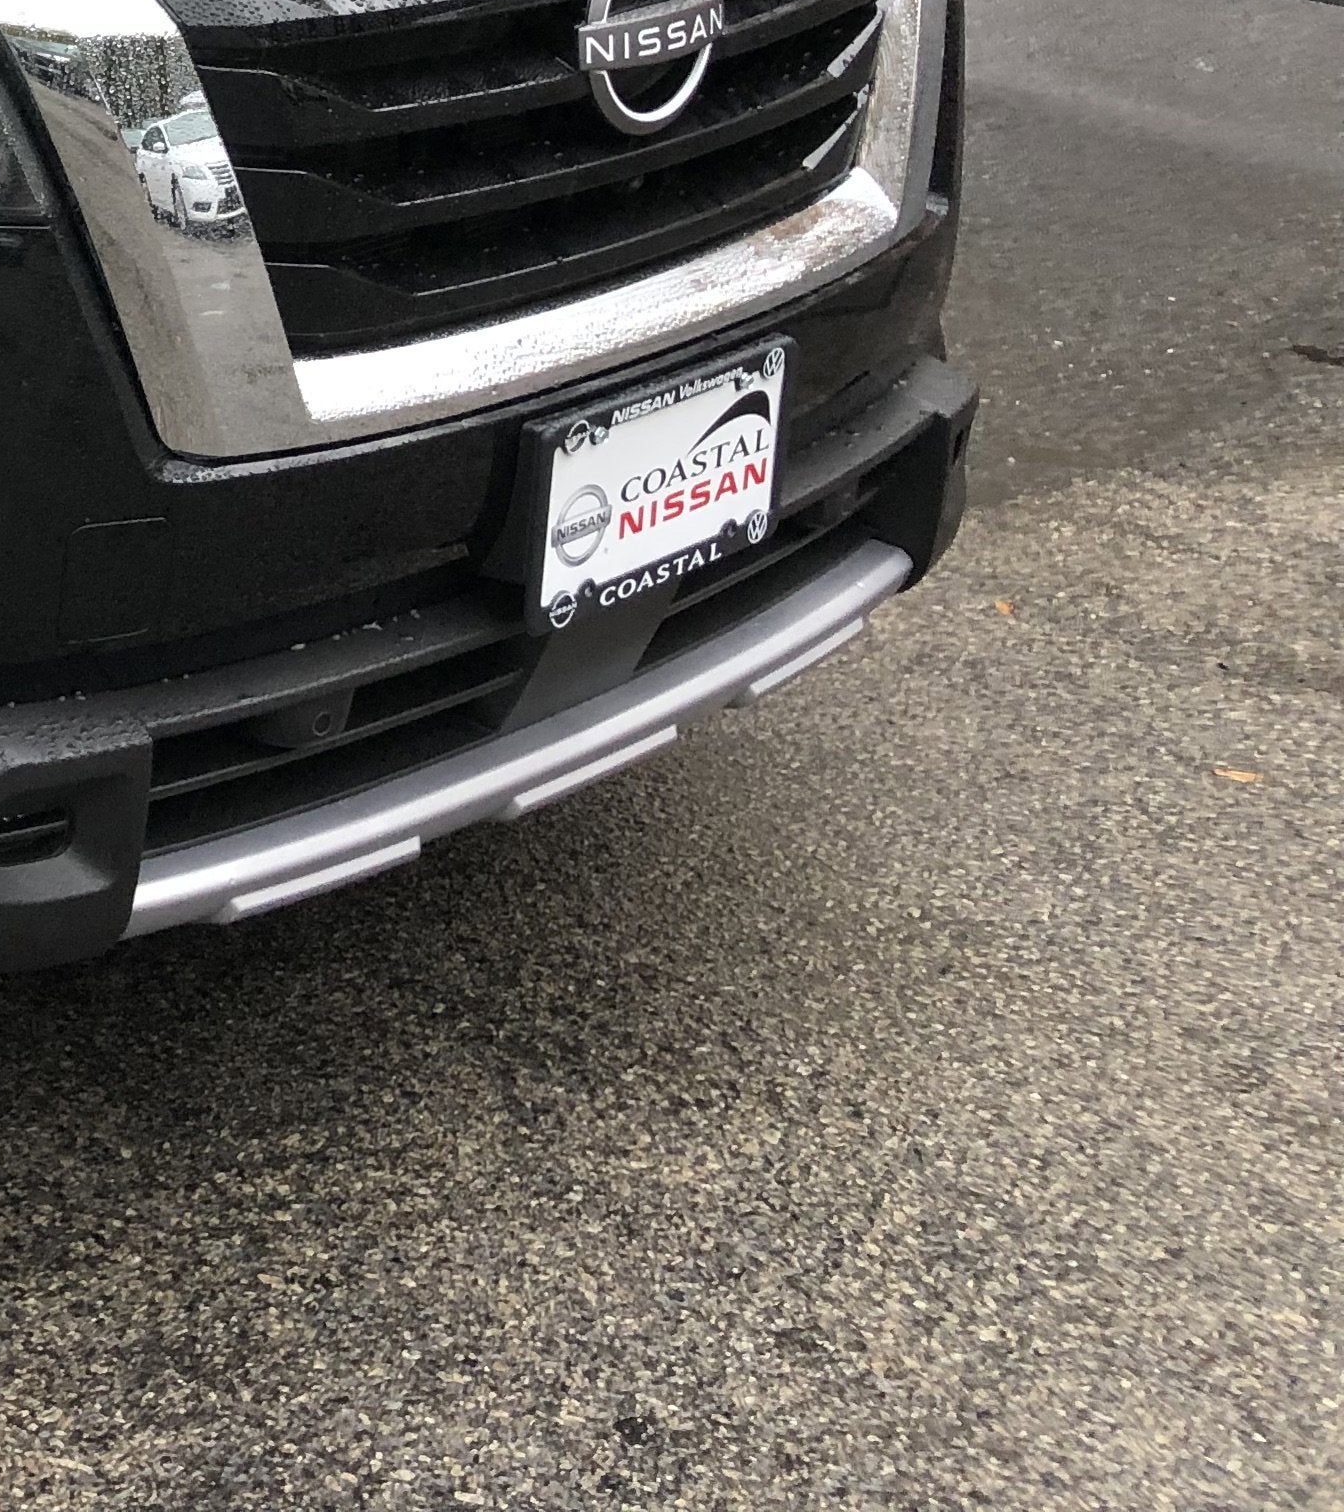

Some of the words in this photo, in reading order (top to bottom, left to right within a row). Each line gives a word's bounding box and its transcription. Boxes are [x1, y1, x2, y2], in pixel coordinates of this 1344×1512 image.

[585, 3, 723, 64] NISSAN
[611, 389, 676, 425] NISSAN
[620, 428, 771, 503] COASTAL
[557, 510, 606, 542] NISSAN
[618, 457, 768, 540] NISSAN
[599, 542, 722, 607] COASTAL
